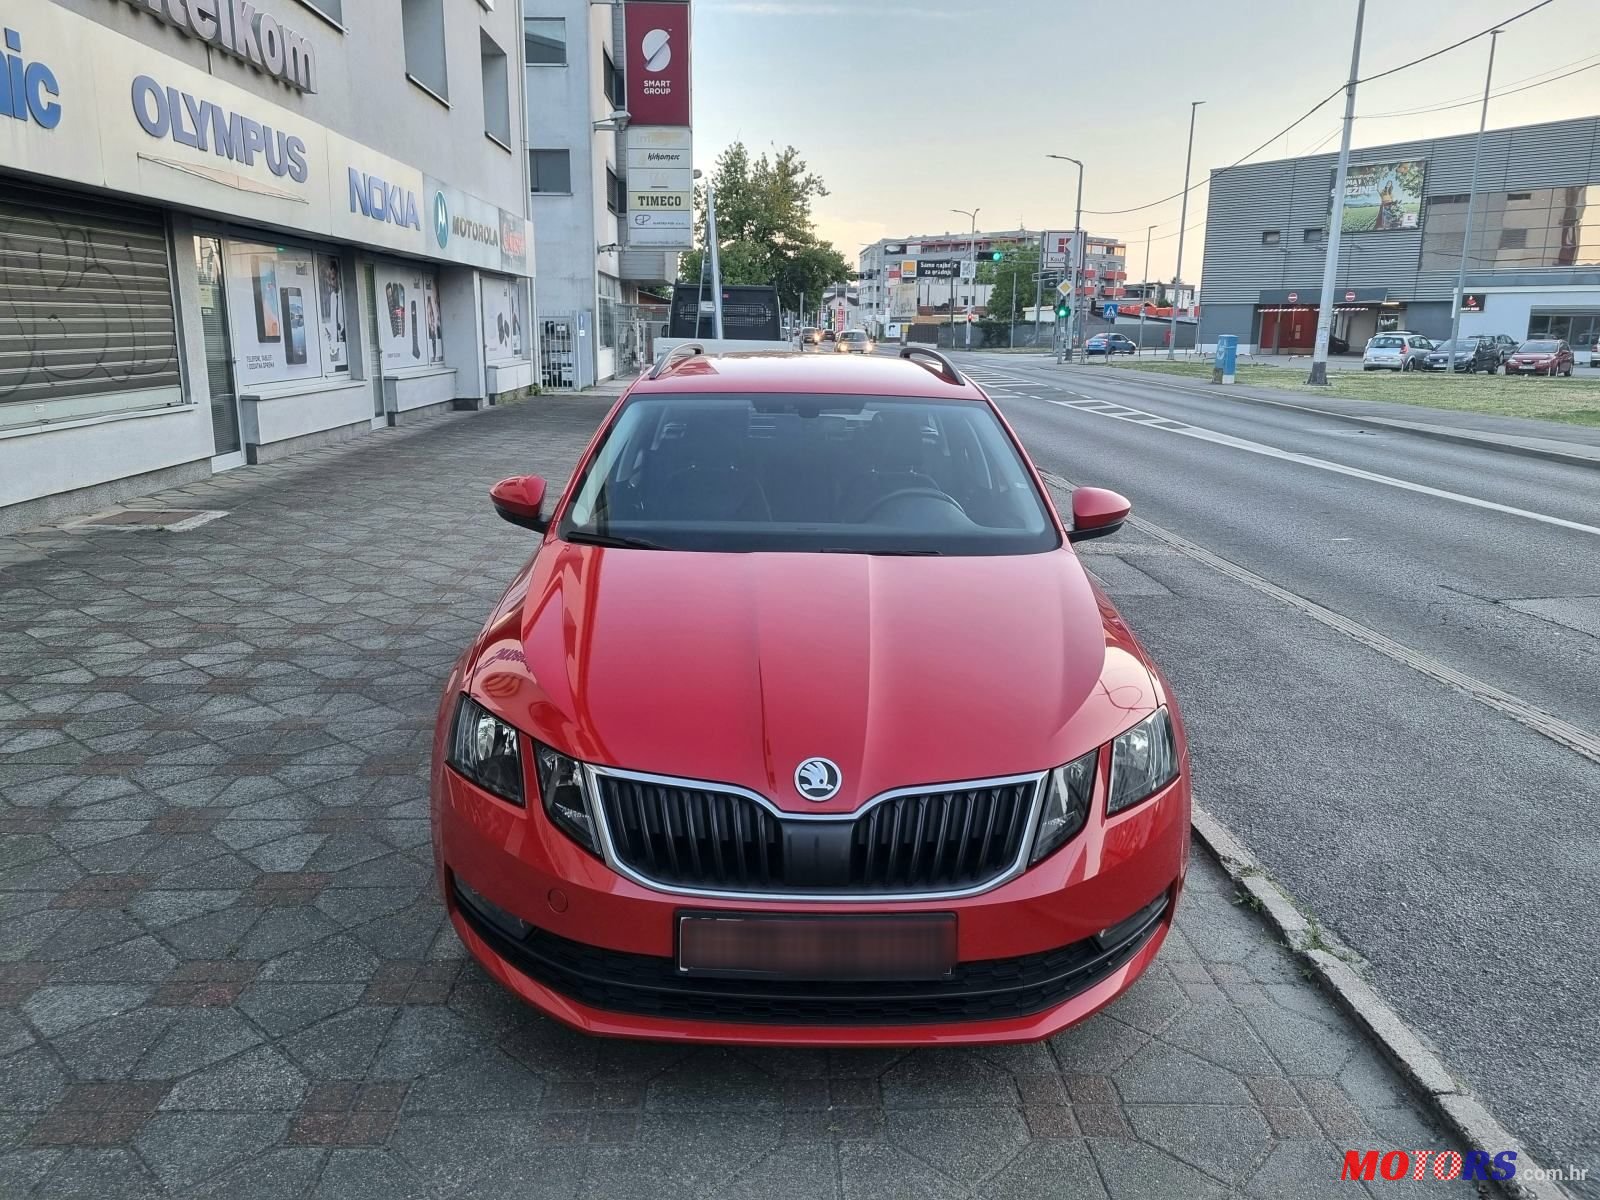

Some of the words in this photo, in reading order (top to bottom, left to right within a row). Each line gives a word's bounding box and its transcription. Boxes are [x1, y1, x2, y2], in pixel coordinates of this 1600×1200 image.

[643, 80, 671, 88] SMART
[131, 74, 308, 184] OLYMPUS
[348, 167, 420, 231] NOKIA
[638, 196, 681, 207] TIMECO
[452, 215, 499, 247] MOTOROLA
